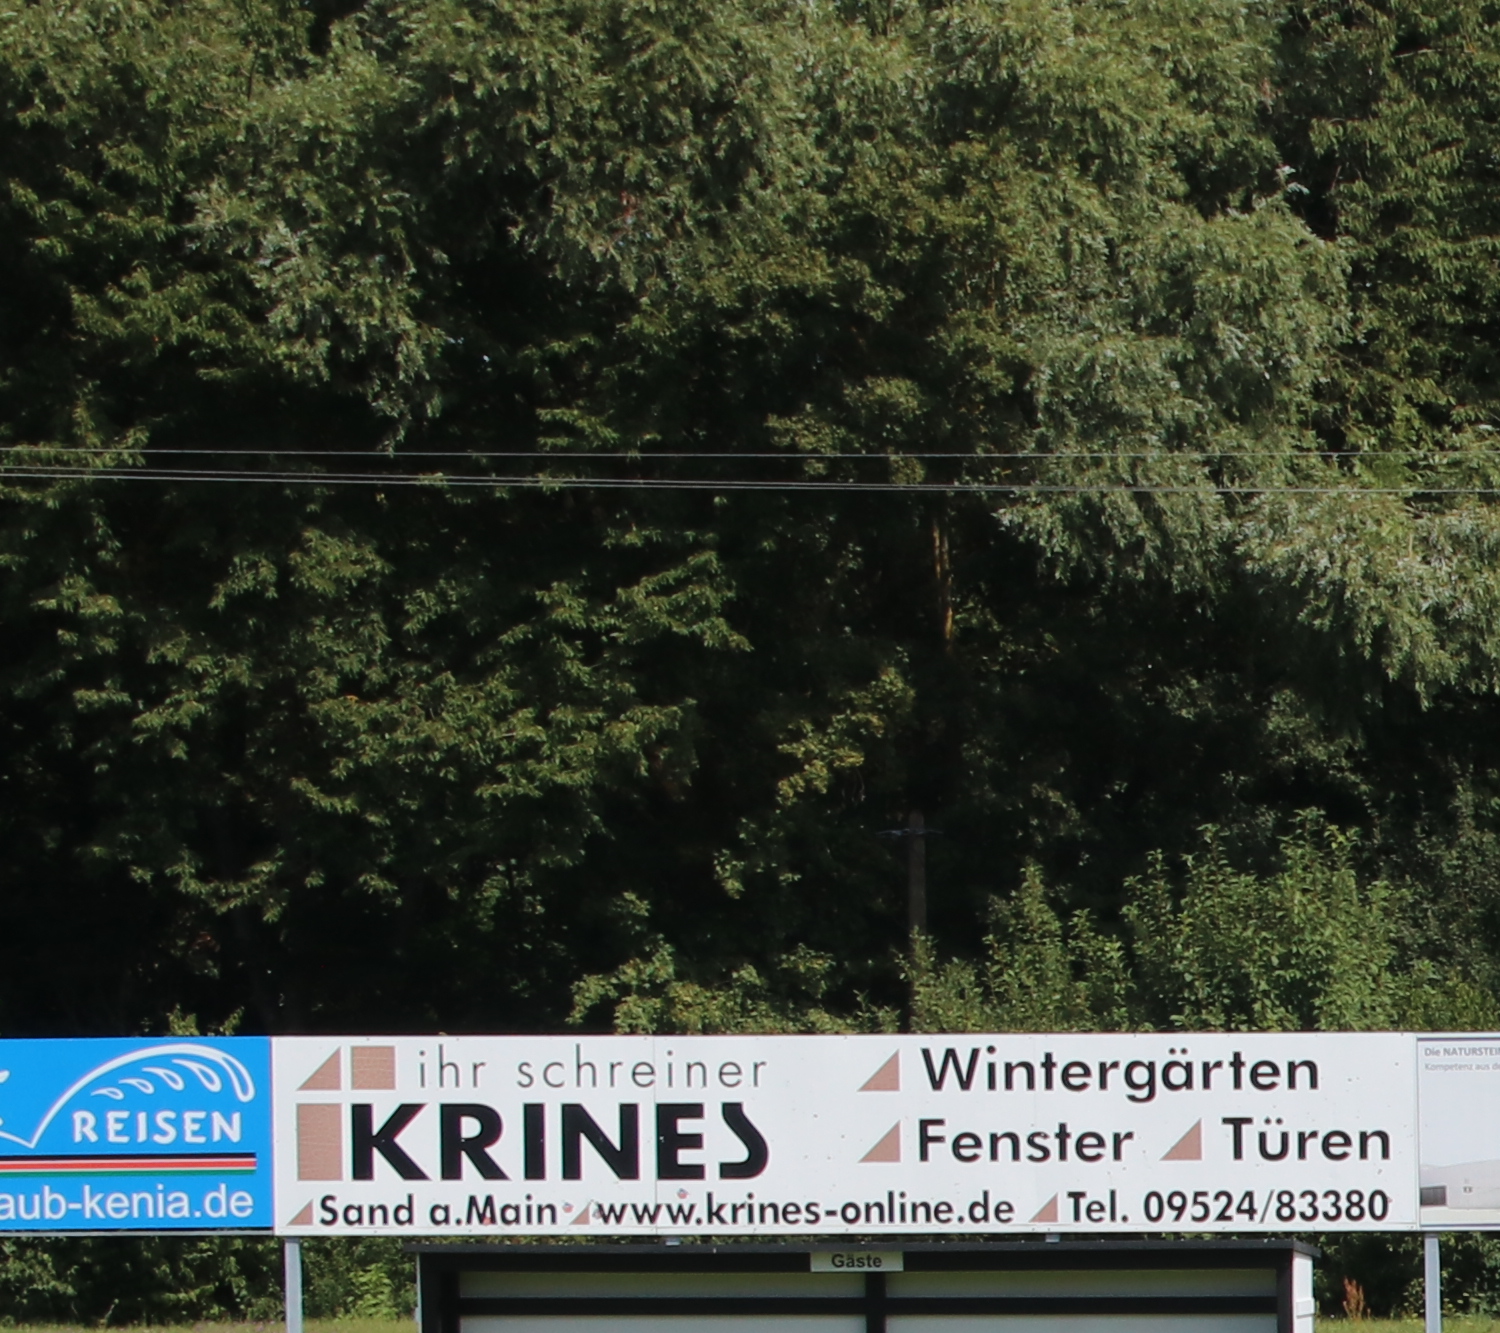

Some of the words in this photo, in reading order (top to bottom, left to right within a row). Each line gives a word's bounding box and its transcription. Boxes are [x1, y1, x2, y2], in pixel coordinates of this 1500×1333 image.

[419, 1045, 486, 1088] ihr
[518, 1044, 768, 1088] schreiner
[1425, 1047, 1441, 1056] Die
[1425, 1063, 1473, 1072] Kompetenz
[921, 1046, 1319, 1101] Wintergärten
[72, 1111, 242, 1144] REISEN
[351, 1103, 769, 1181] KRINES
[919, 1119, 1134, 1164] Fenster
[1221, 1116, 1391, 1161] Türen
[320, 1195, 414, 1226] Sand
[429, 1195, 558, 1226] a.Main
[600, 1191, 1015, 1225] www.krines-online.de
[1067, 1192, 1128, 1223] Tel.
[1143, 1190, 1389, 1224] 09524/83380
[831, 1251, 882, 1270] Gäste
